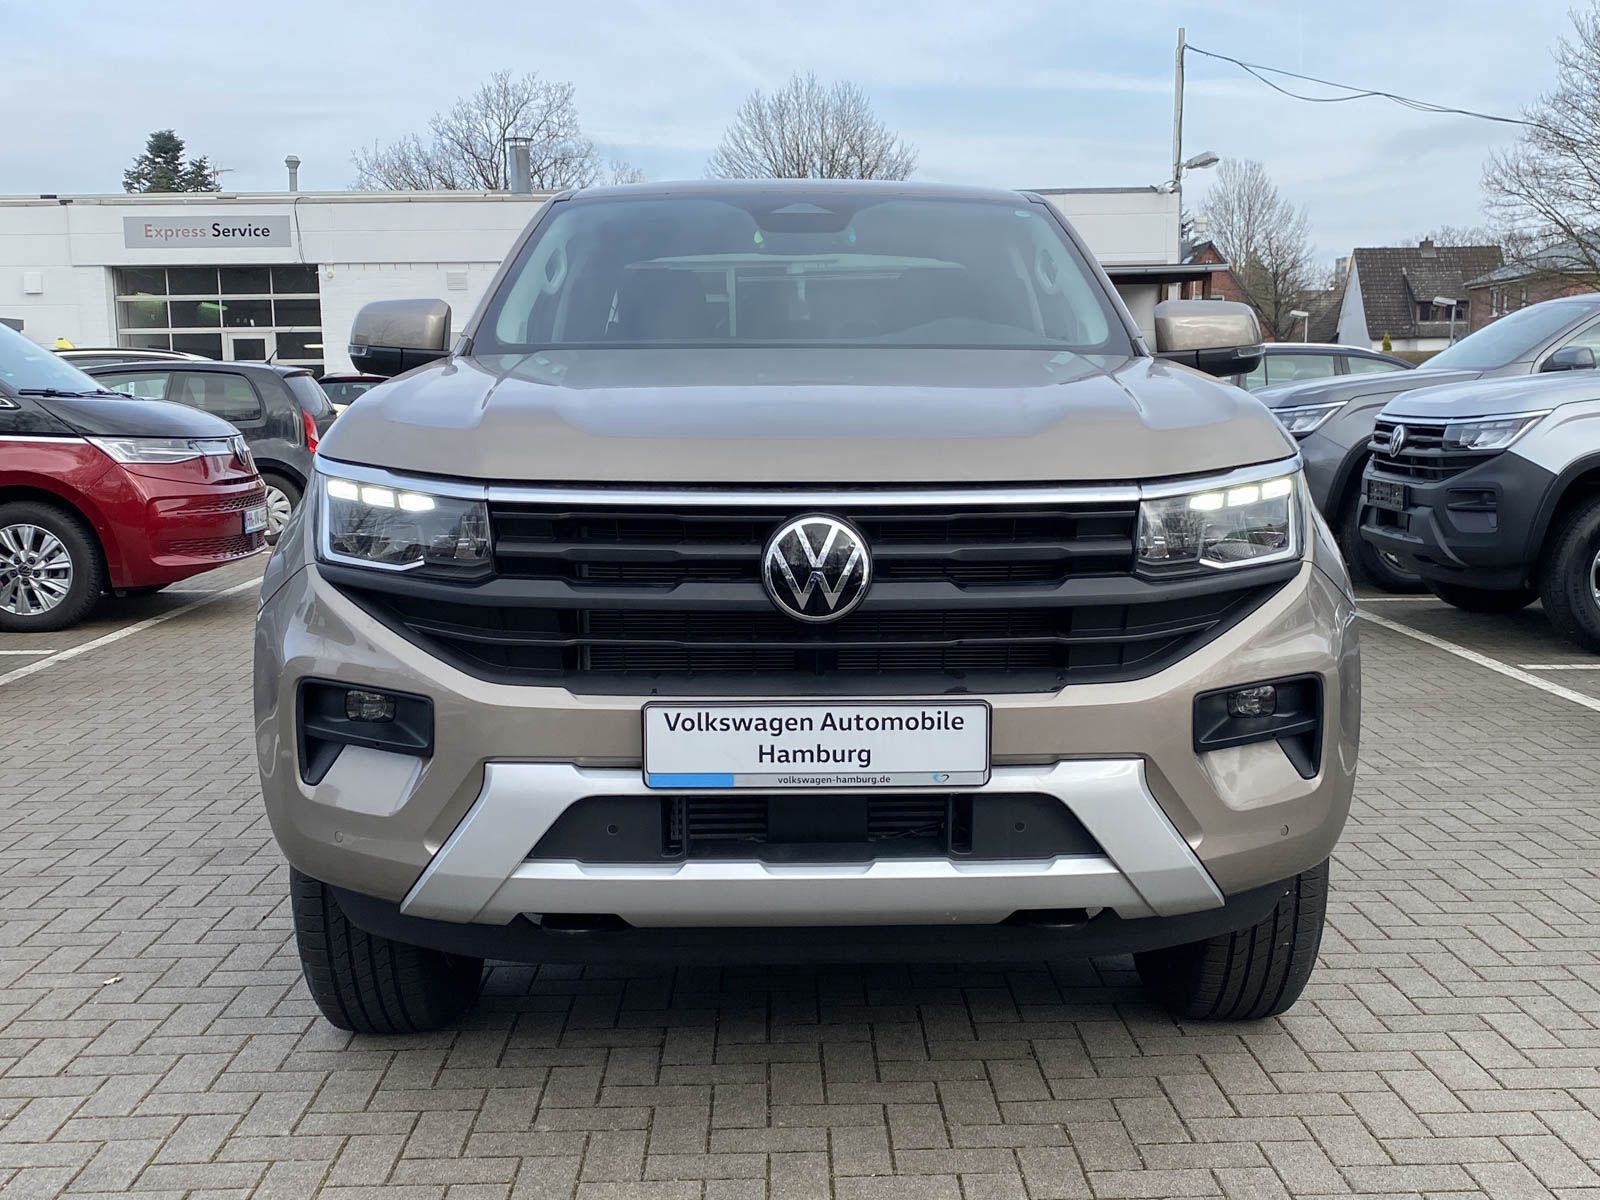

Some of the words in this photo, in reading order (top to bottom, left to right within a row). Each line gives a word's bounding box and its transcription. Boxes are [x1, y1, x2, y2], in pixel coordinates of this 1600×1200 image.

[144, 224, 207, 240] Express
[211, 223, 271, 238] Service
[766, 518, 868, 617] VW
[663, 711, 814, 737] Volkswagen
[819, 710, 965, 732] Automobile
[758, 743, 871, 769] Hamburg
[777, 775, 891, 786] volkswagen-hamburg.de
